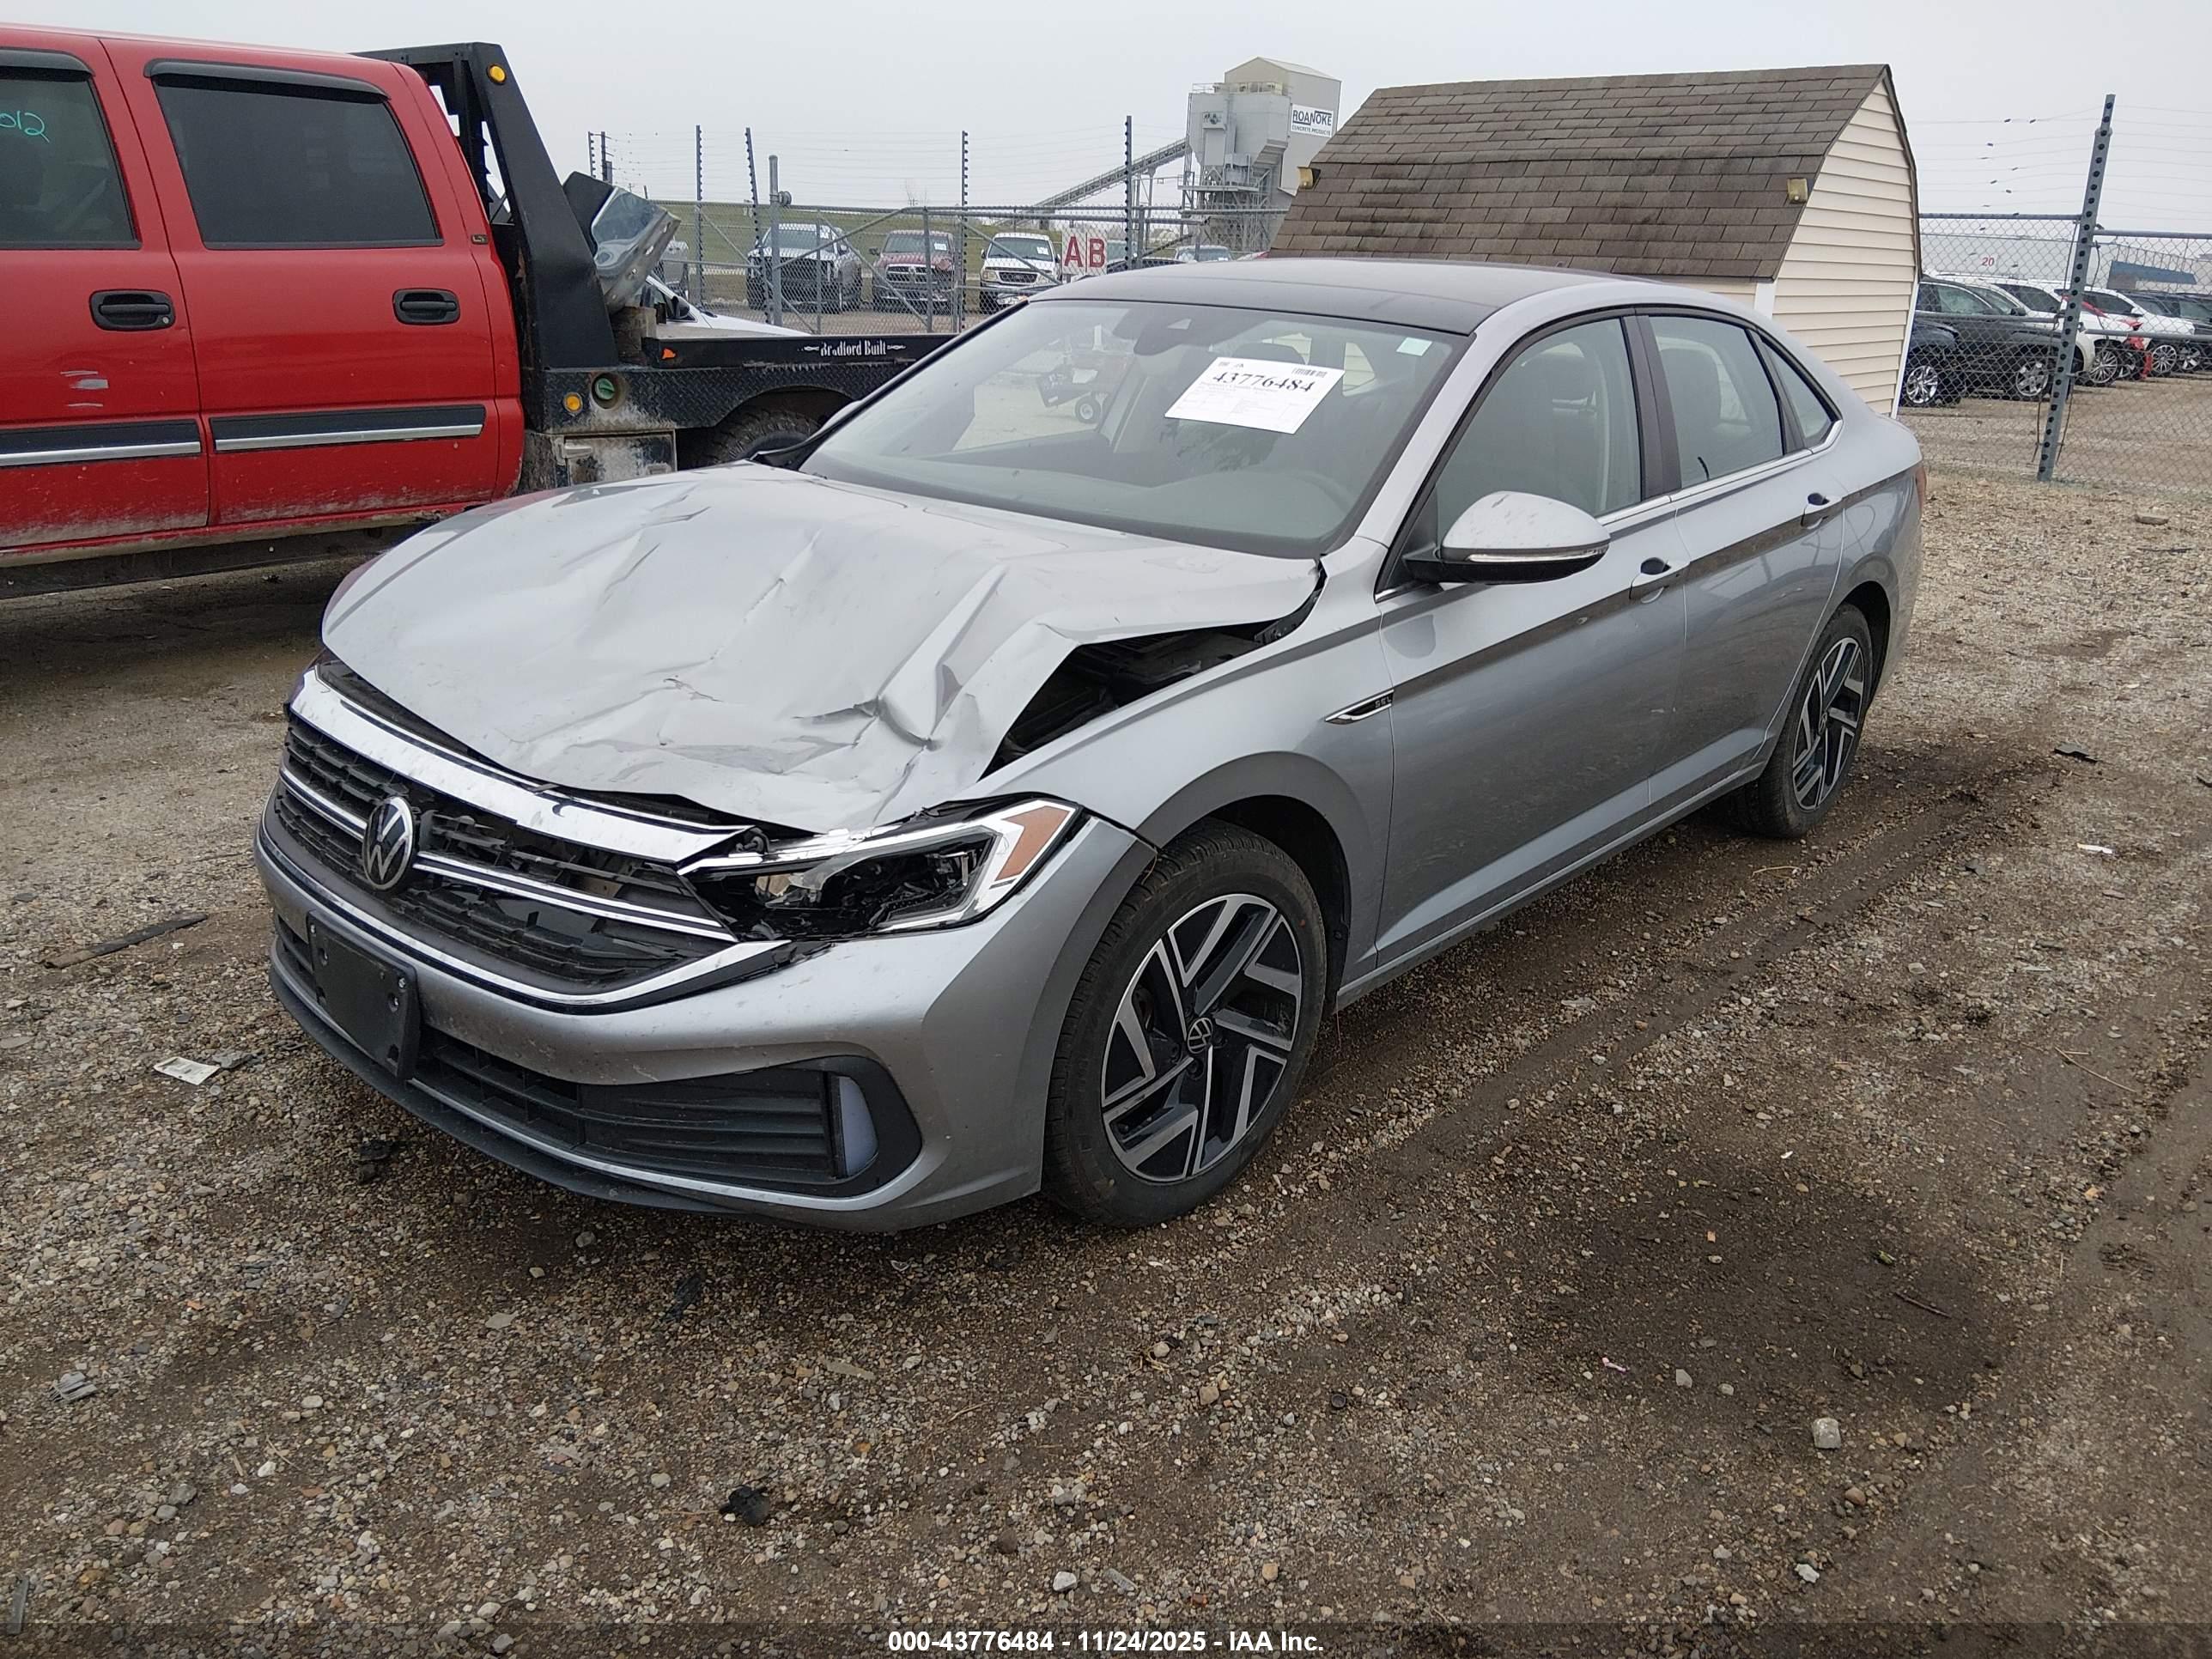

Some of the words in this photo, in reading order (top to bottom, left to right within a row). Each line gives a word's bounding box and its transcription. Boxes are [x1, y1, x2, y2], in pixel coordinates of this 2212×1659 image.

[1292, 109, 1332, 126] ROANOKE
[1982, 257, 1995, 267] 20
[864, 339, 887, 356] Built
[1212, 371, 1315, 392] 43776484
